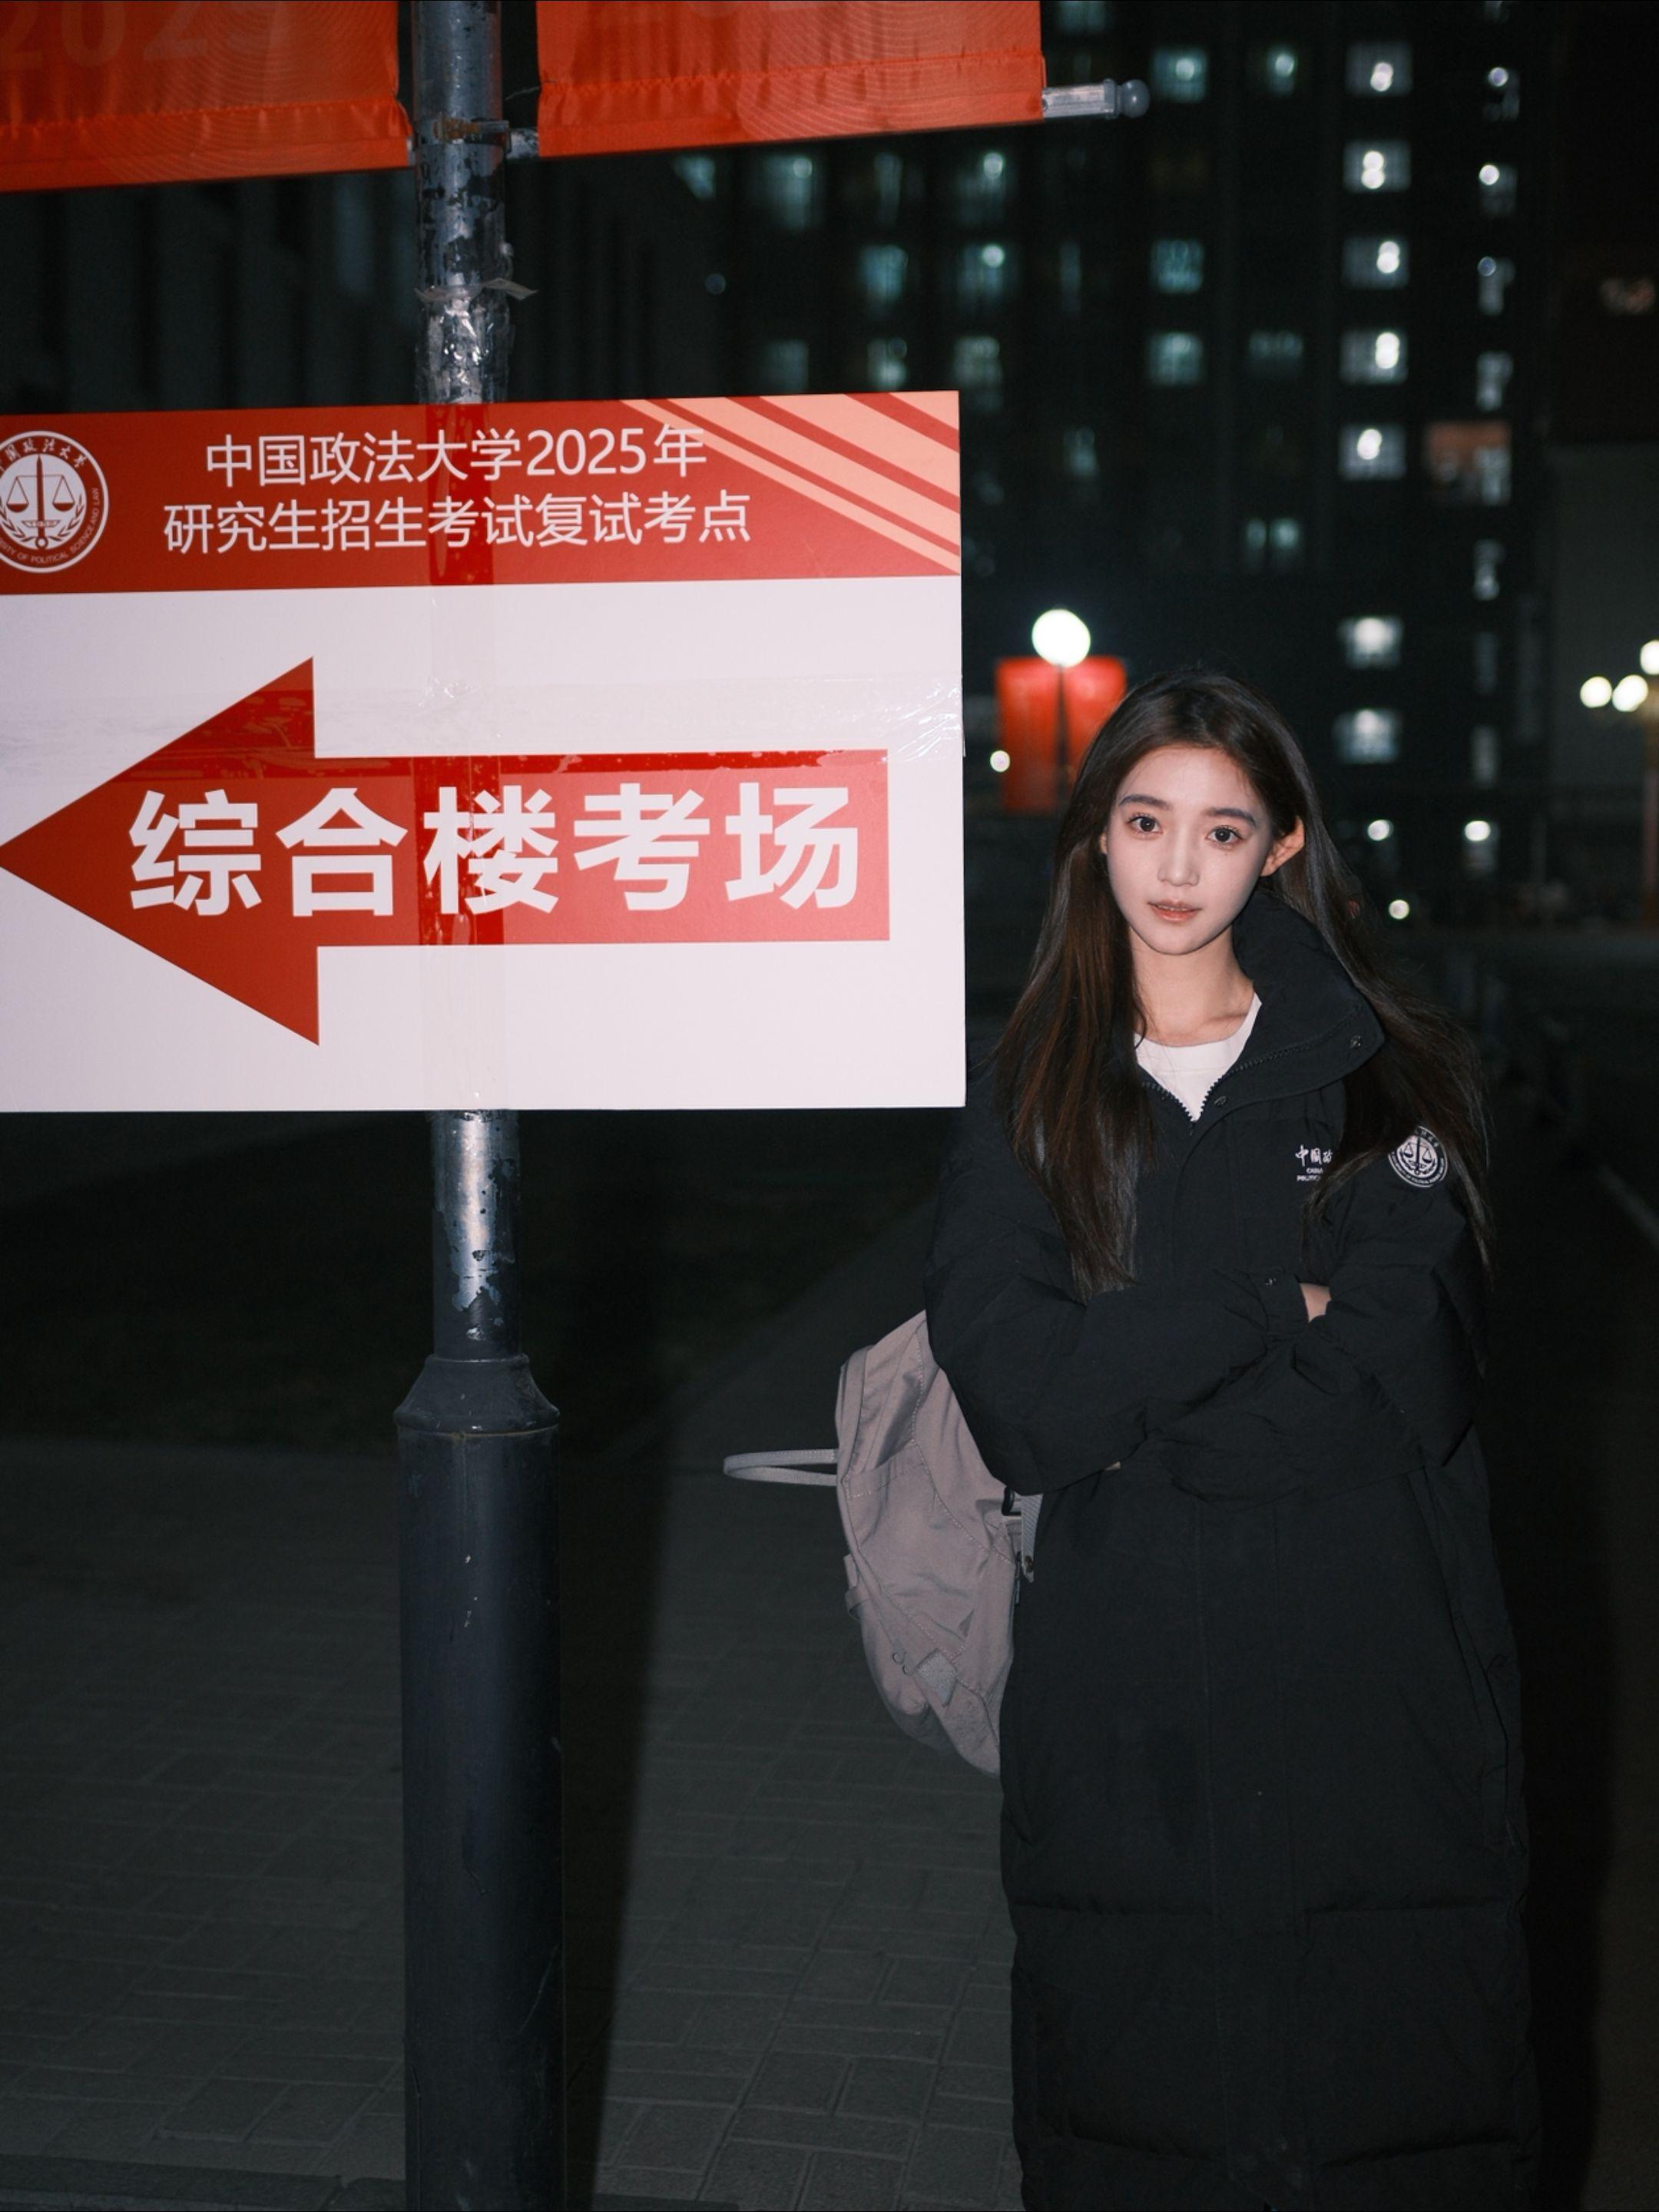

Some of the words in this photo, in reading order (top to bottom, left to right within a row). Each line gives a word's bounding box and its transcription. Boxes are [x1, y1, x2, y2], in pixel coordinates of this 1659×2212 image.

[206, 424, 707, 488] 中国政法大学2025年
[164, 489, 751, 553] 研究生招生考试复试考点
[130, 781, 859, 918] 综合楼考场
